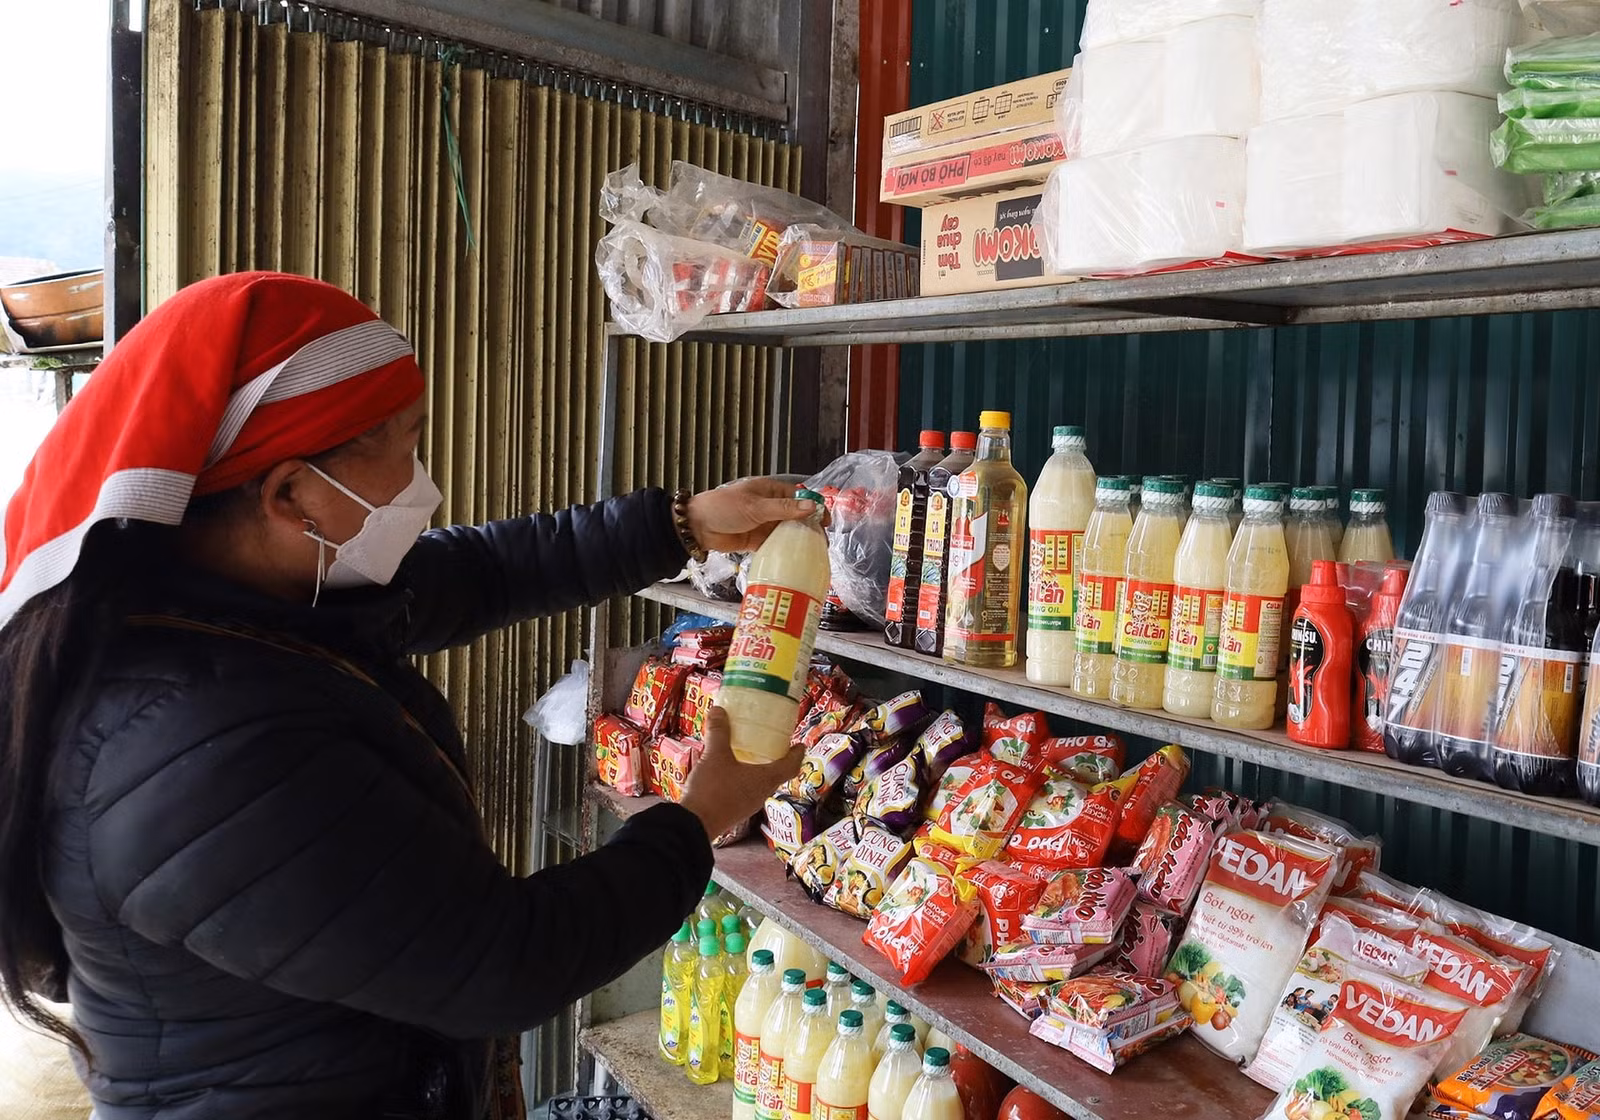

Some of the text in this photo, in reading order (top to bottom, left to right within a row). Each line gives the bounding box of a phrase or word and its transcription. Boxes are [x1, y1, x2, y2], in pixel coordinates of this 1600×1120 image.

[897, 170, 919, 190] MỚI
[921, 168, 937, 187] BÒ
[939, 161, 965, 183] PHỞ
[940, 213, 960, 232] cay
[973, 223, 1041, 268] OKOMI
[1387, 640, 1431, 721] 247
[863, 829, 901, 854] CUNG
[1009, 833, 1022, 846] G
[1212, 836, 1307, 899] VEDAN
[1199, 910, 1218, 926] hiết
[1202, 891, 1256, 926] Bột ngọt
[995, 918, 1009, 947] PH
[1412, 932, 1493, 1003] VEDAN
[1345, 983, 1443, 1043] VEDAN
